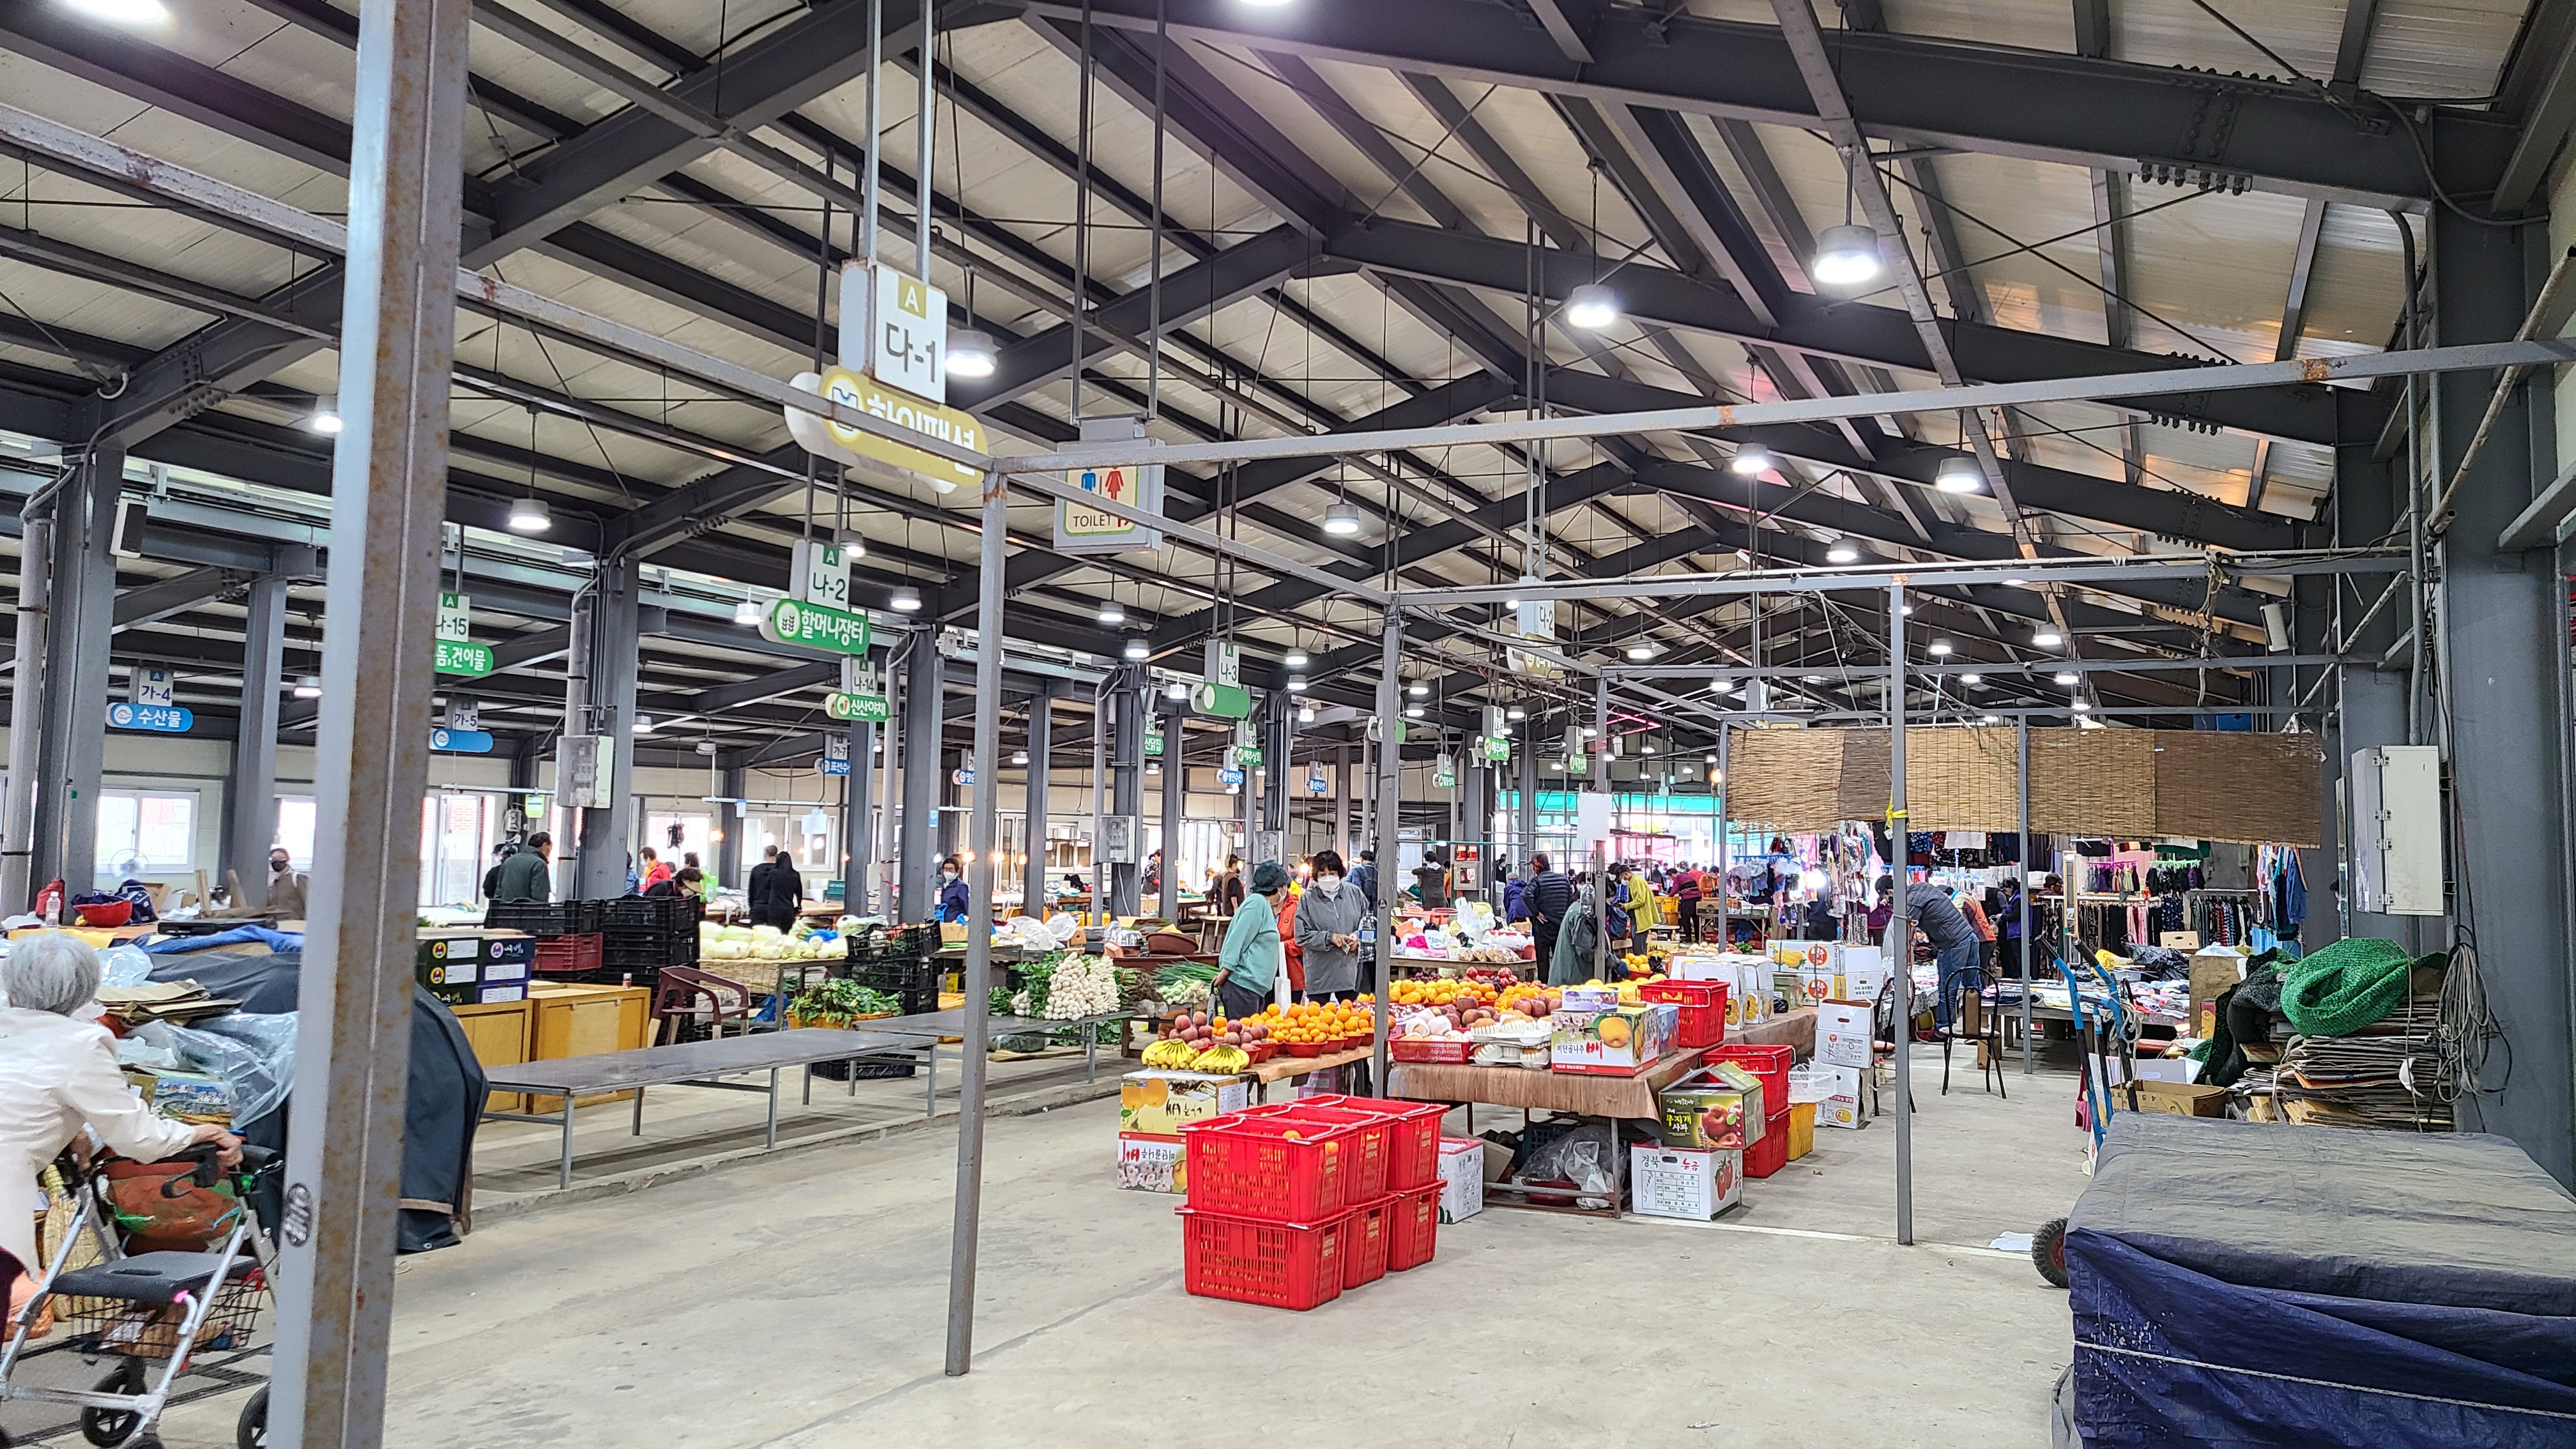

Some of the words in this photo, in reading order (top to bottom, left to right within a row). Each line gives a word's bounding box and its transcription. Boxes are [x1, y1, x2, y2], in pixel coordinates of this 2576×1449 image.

[904, 285, 919, 313] A
[885, 321, 936, 383] 다-1
[1073, 514, 1110, 528] TOILET
[825, 550, 836, 564] A
[813, 572, 847, 602] 나-2
[445, 595, 454, 607] A
[801, 608, 864, 647] 할머니장터
[1539, 605, 1554, 632] 다-2
[436, 644, 486, 671] 돔,건어물
[1227, 645, 1232, 656] A
[1220, 662, 1238, 682] 나-3
[854, 675, 875, 693] 나-14
[141, 685, 171, 702] 가-4
[137, 708, 182, 728] 수산물
[455, 713, 477, 727] 가-5
[829, 760, 850, 774] 표선수
[1557, 1043, 1585, 1055] 비단골나주
[1586, 1039, 1604, 1061] 배
[1165, 1098, 1181, 1117] 배
[1666, 1114, 1692, 1127] 무지개
[1672, 1123, 1689, 1133] 사과
[1121, 1140, 1140, 1163] 배
[1641, 1154, 1660, 1169] 경북
[1680, 1157, 1700, 1172] 능금
